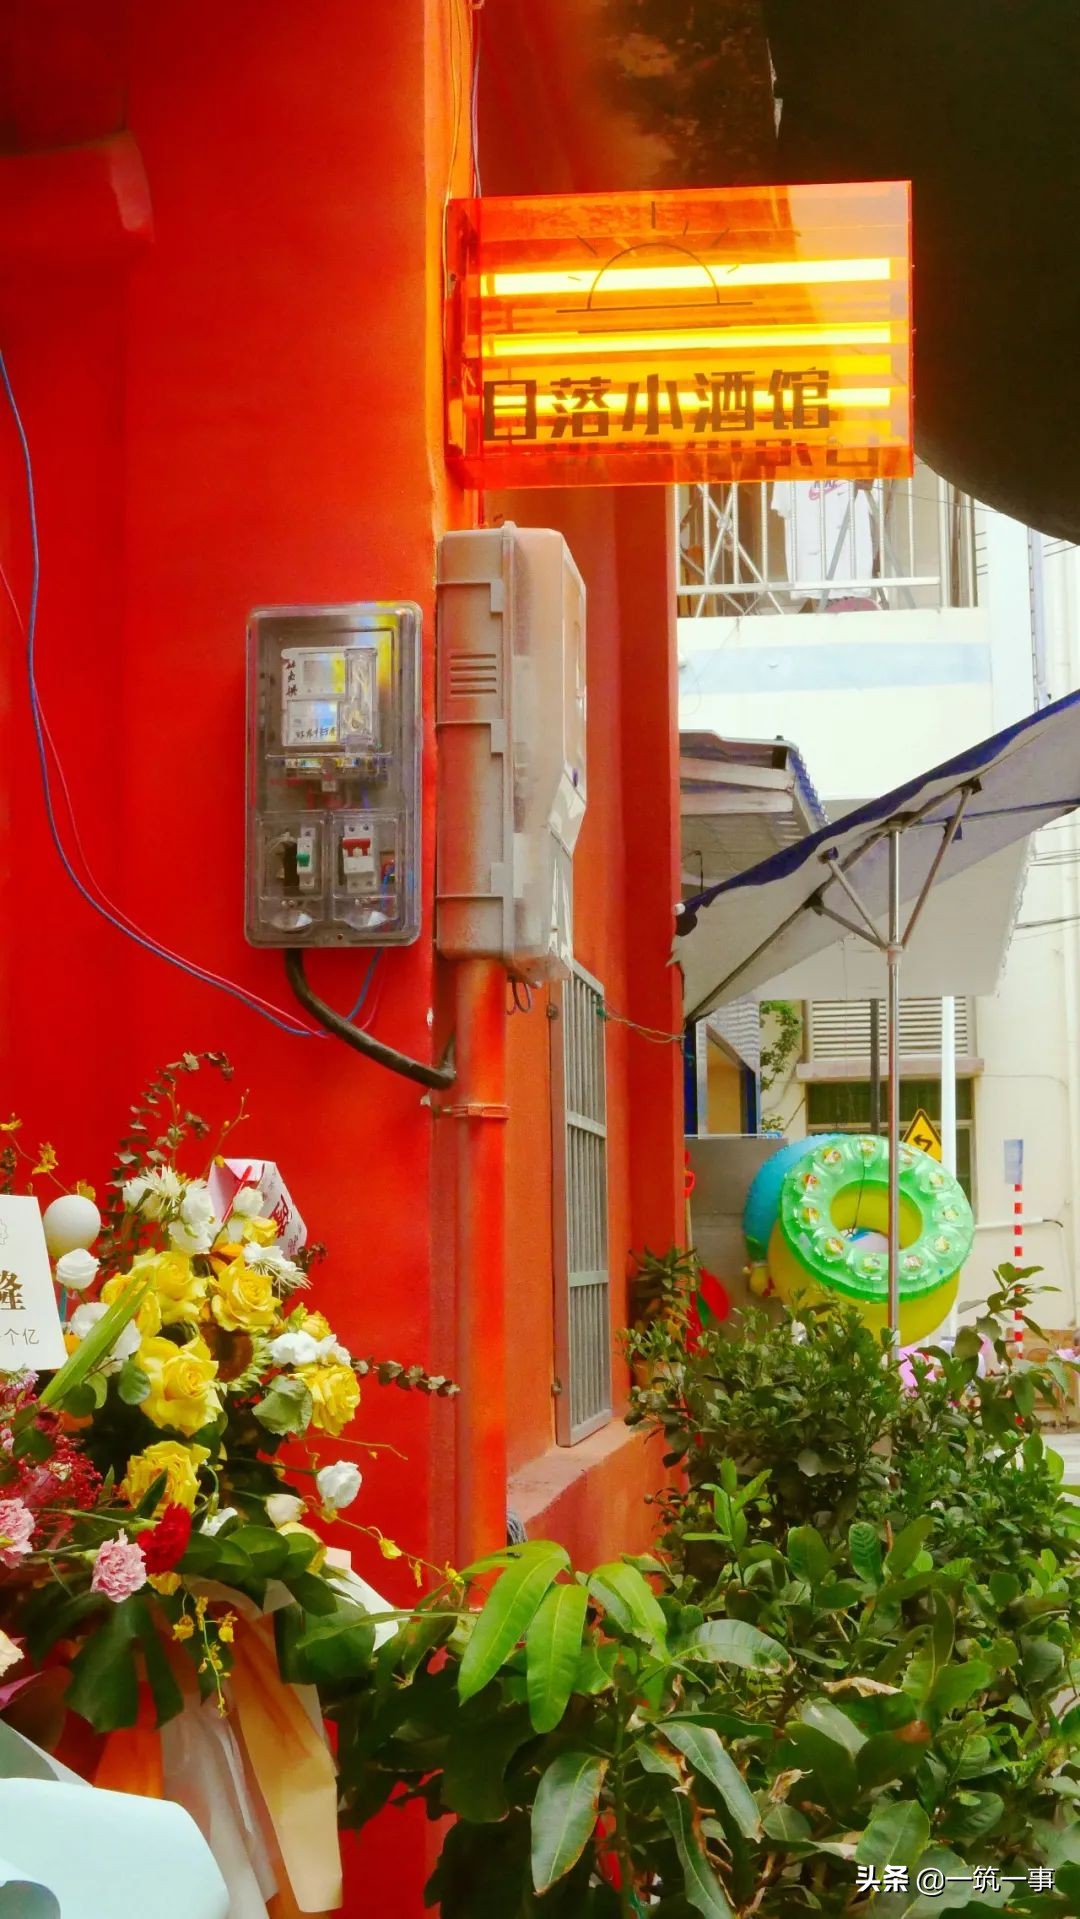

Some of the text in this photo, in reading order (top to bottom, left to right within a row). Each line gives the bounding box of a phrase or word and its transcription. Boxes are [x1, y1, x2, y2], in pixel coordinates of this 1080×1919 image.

[483, 367, 831, 441] 日落小酒馆
[0, 1327, 40, 1346] 个亿
